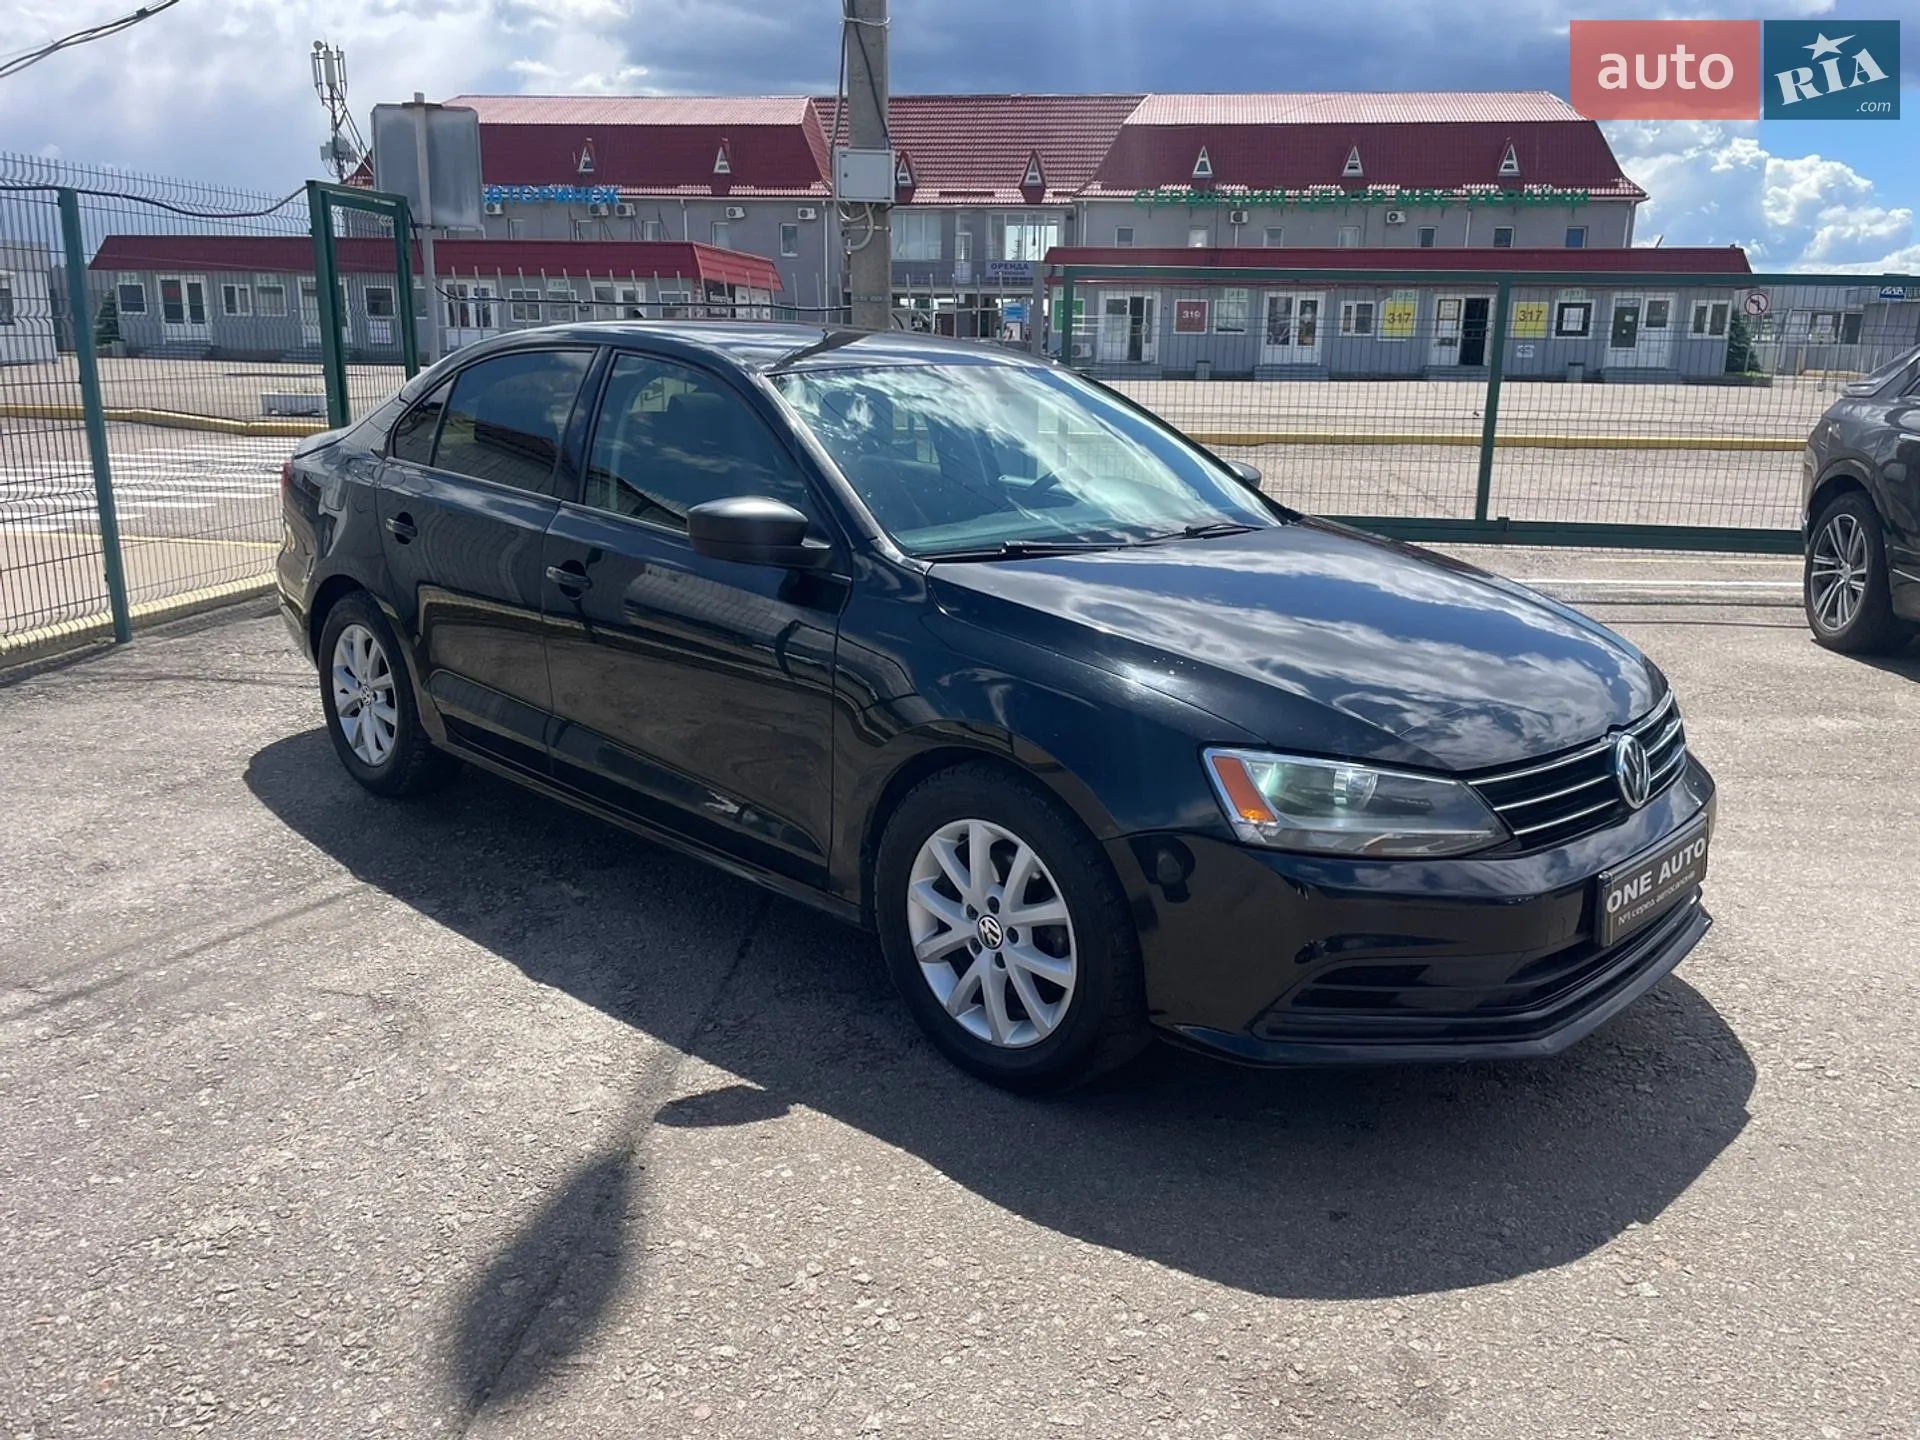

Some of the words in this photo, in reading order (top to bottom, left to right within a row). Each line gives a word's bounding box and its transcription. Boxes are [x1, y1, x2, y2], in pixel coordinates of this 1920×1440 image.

[990, 262, 1030, 271] ОРЕНДА
[1388, 312, 1412, 324] 317
[1518, 309, 1543, 322] 317
[1607, 871, 1652, 913] ONE
[1658, 838, 1705, 884] AUTO
